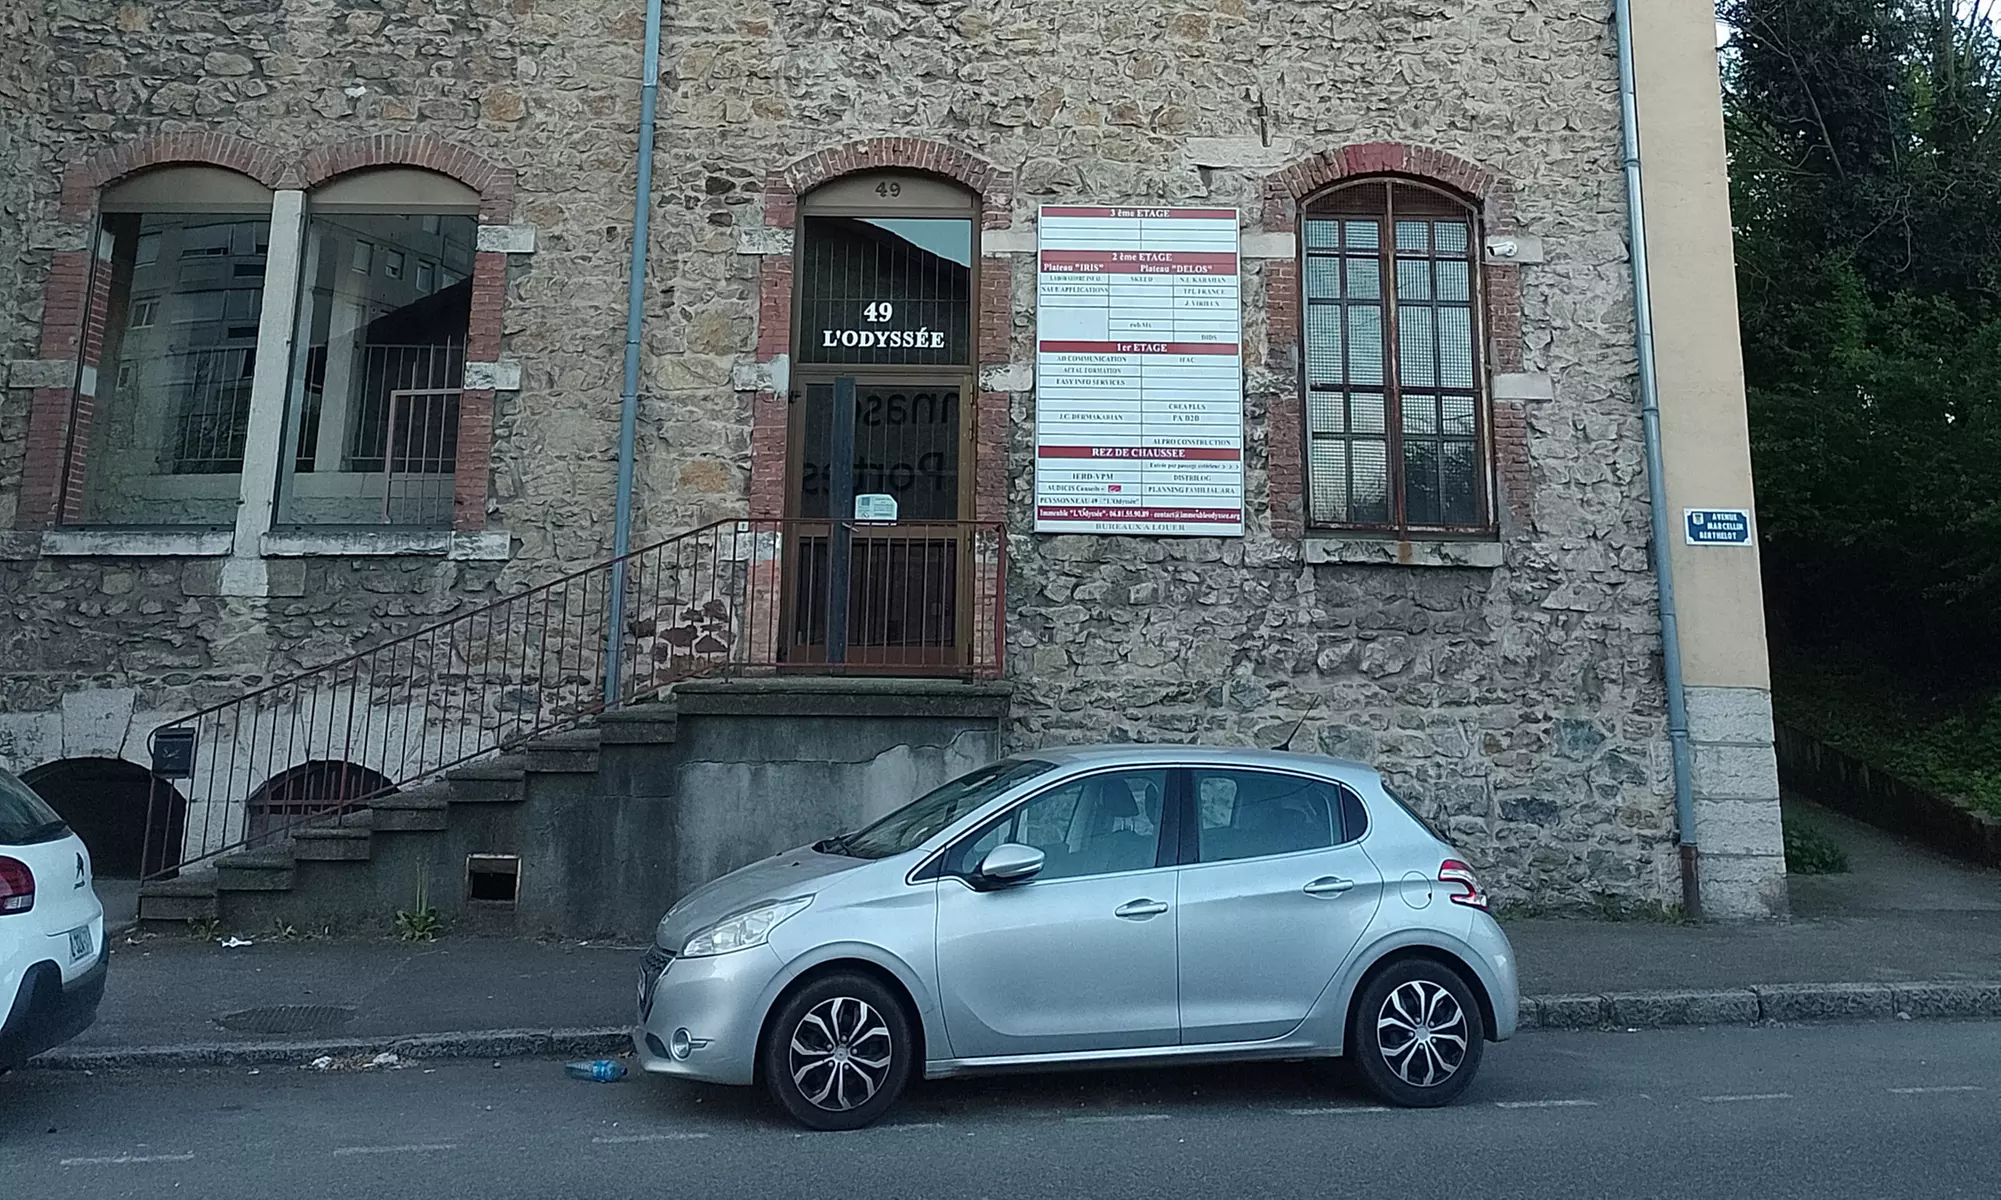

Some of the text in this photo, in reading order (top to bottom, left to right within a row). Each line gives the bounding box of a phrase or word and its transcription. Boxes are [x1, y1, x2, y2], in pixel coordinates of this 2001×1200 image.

[875, 181, 901, 198] 49
[1109, 208, 1116, 217] 3
[1136, 209, 1171, 218] ETAGE
[1111, 252, 1118, 261] 2
[1138, 253, 1173, 262] ETAGE
[1043, 263, 1074, 272] Plateau
[1140, 264, 1170, 273] Plateau
[863, 302, 893, 323] 49
[822, 326, 945, 348] L'ODYSSÉE
[1116, 343, 1168, 353] 1er ETAGE
[1067, 355, 1127, 363] COMMUNICATION
[1177, 439, 1231, 447] CONSTRUCTION
[1091, 447, 1186, 458] REZ DE CHAUSSEE
[1148, 485, 1184, 494] PLANNING
[1711, 513, 1738, 521] AVENUE
[1095, 523, 1142, 531] BUREAUX
[1152, 524, 1186, 532] LOUER
[1706, 522, 1744, 530] MARCELLIN
[1699, 531, 1737, 540] BERTHELOT
